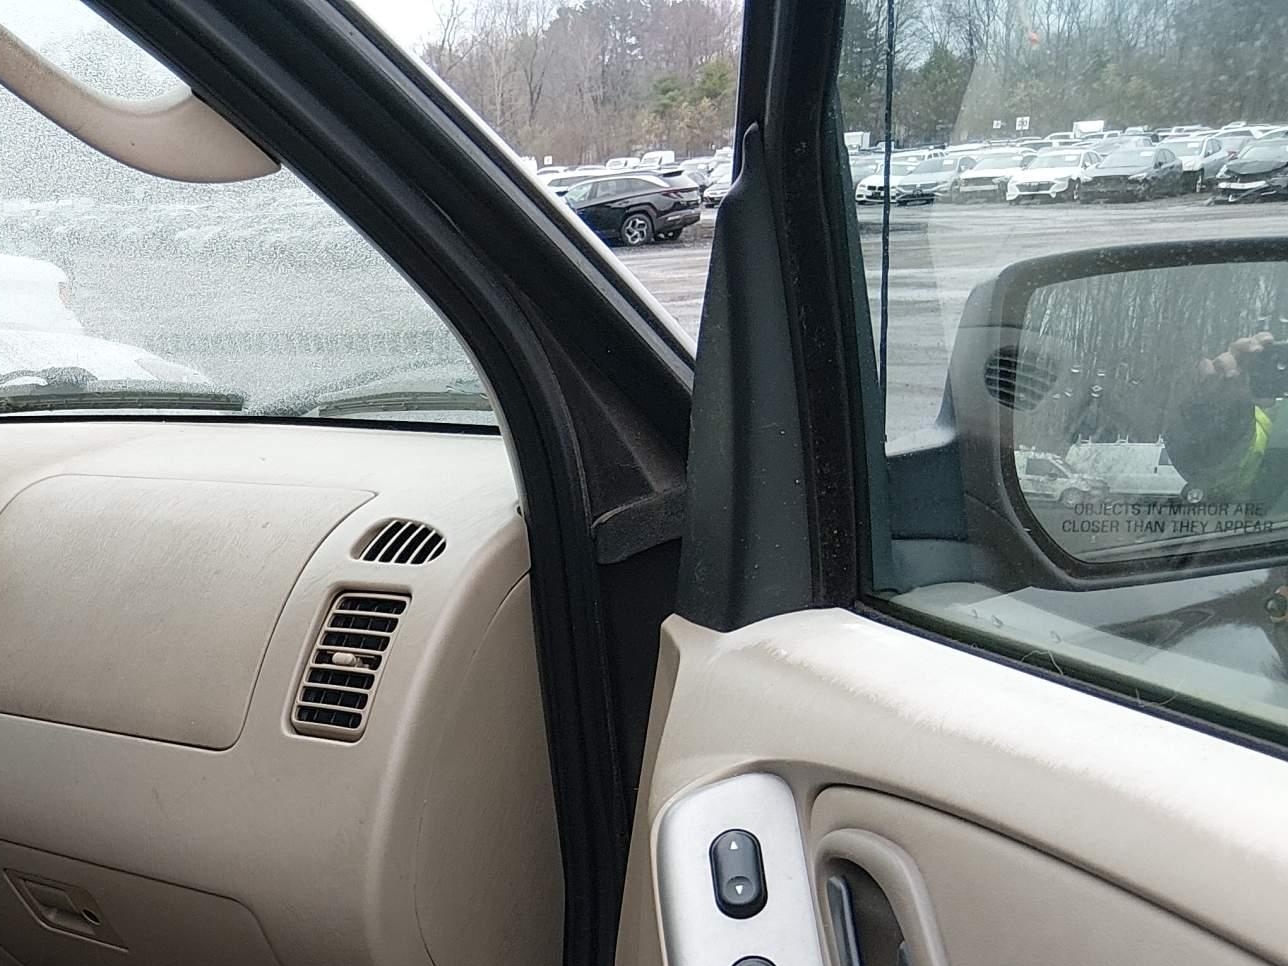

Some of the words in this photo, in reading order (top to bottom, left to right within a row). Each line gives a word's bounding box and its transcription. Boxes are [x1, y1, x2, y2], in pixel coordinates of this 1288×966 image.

[1074, 502, 1141, 516] OBJECTS
[1146, 503, 1163, 516] IN
[1168, 503, 1229, 516] MIRROR
[1233, 503, 1265, 516] ARE
[1061, 519, 1120, 533] CLOSER
[1125, 519, 1165, 533] THAN
[1171, 519, 1209, 533] THEY
[1214, 519, 1274, 533] APPEAR
